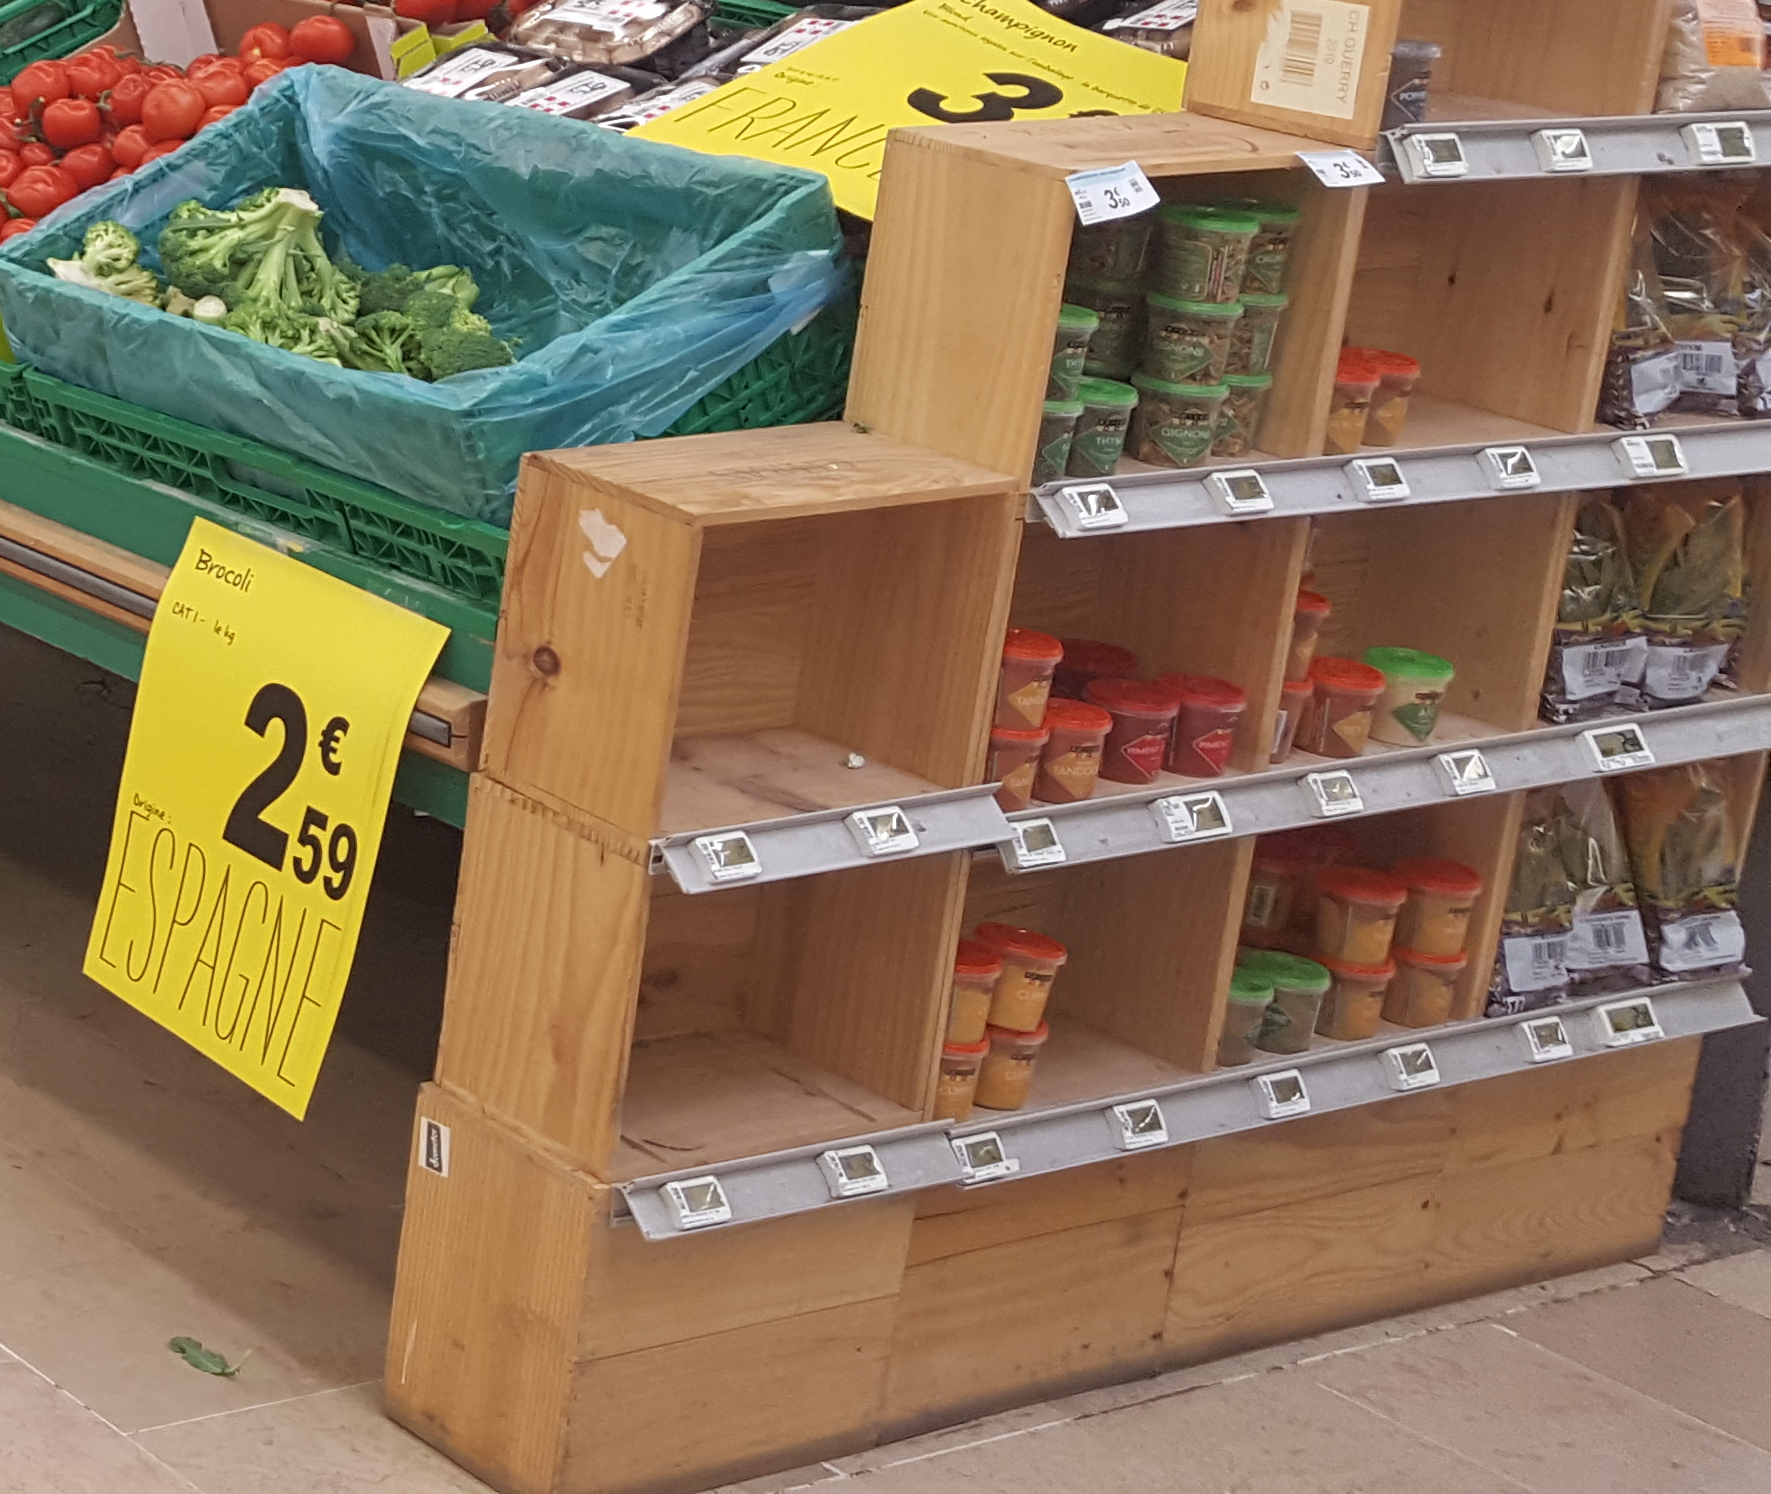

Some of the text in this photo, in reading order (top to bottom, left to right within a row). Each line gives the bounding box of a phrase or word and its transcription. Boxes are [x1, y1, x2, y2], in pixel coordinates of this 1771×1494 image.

[674, 86, 887, 181] FRANC
[194, 548, 256, 594] Brocoli
[99, 810, 343, 1088] ESPAGNE
